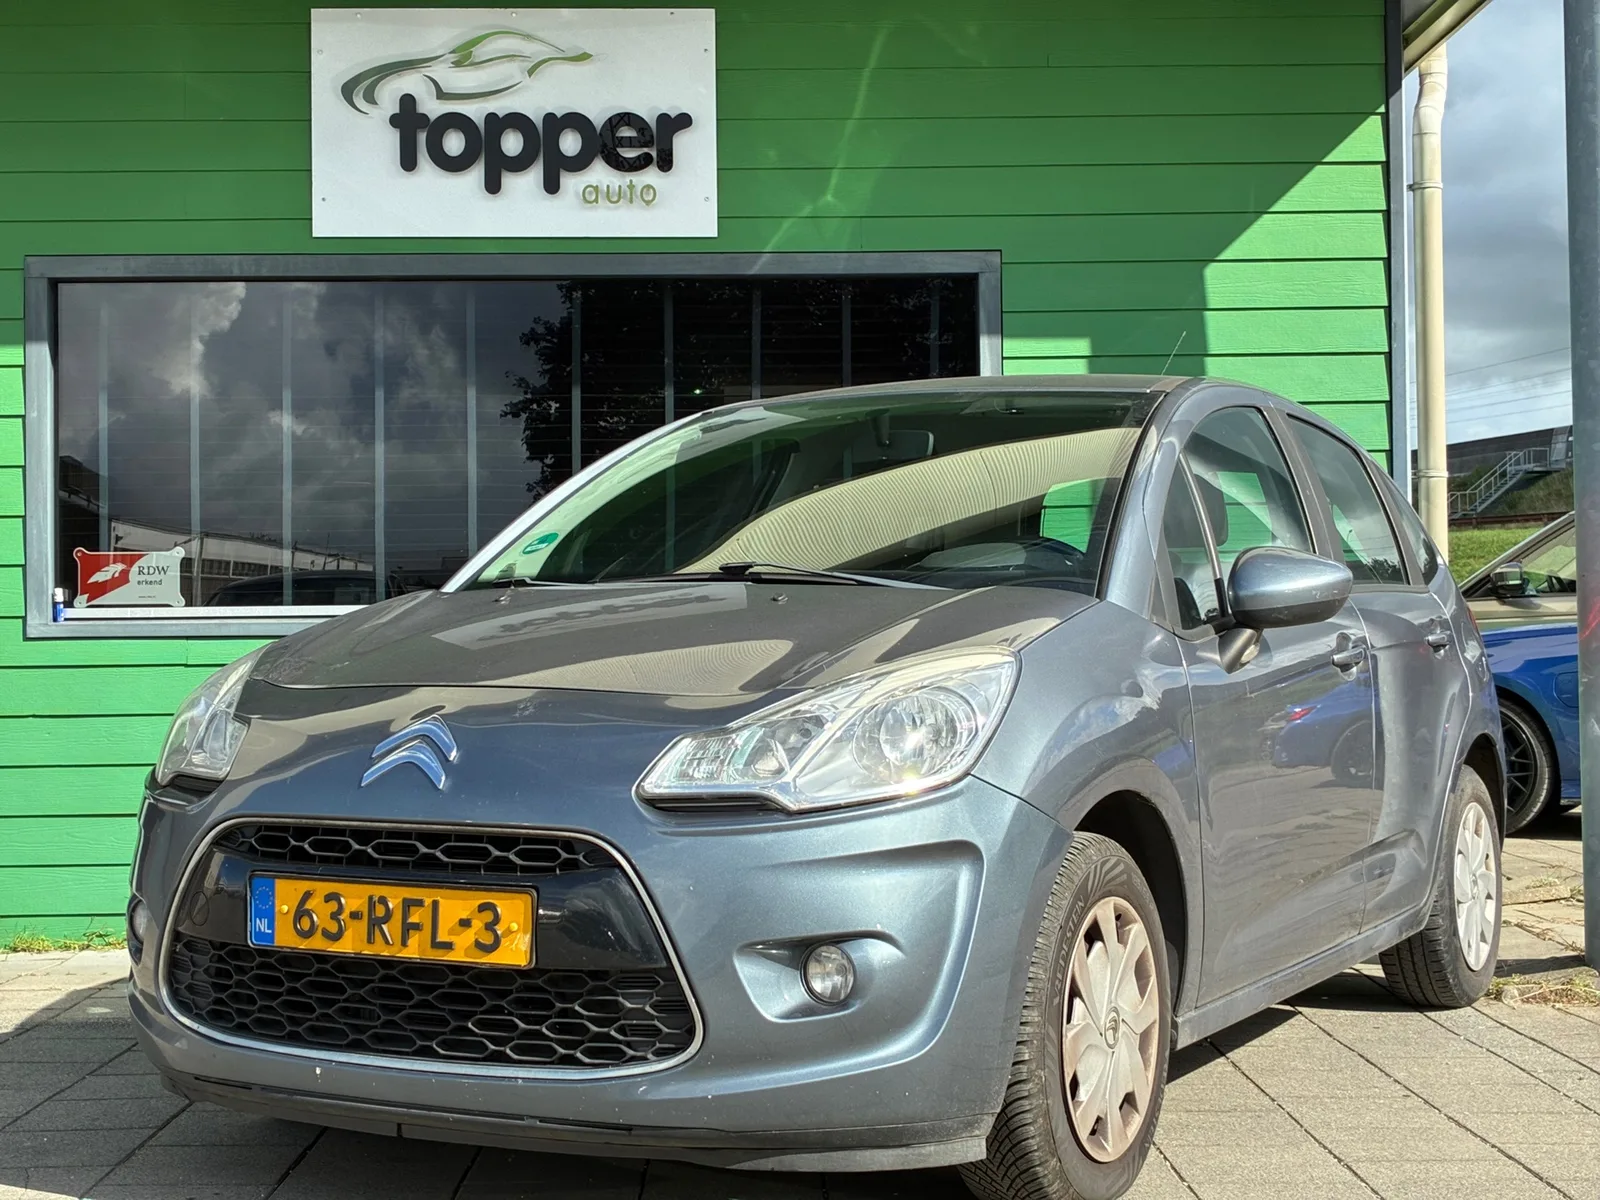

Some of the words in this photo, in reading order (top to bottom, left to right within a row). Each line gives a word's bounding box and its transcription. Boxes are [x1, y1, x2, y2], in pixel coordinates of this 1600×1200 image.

[389, 93, 693, 195] topper
[581, 179, 657, 206] auto
[137, 565, 169, 575] RDW
[137, 578, 163, 586] erkend
[256, 917, 272, 934] NL
[292, 889, 502, 954] 63-RFL-3
